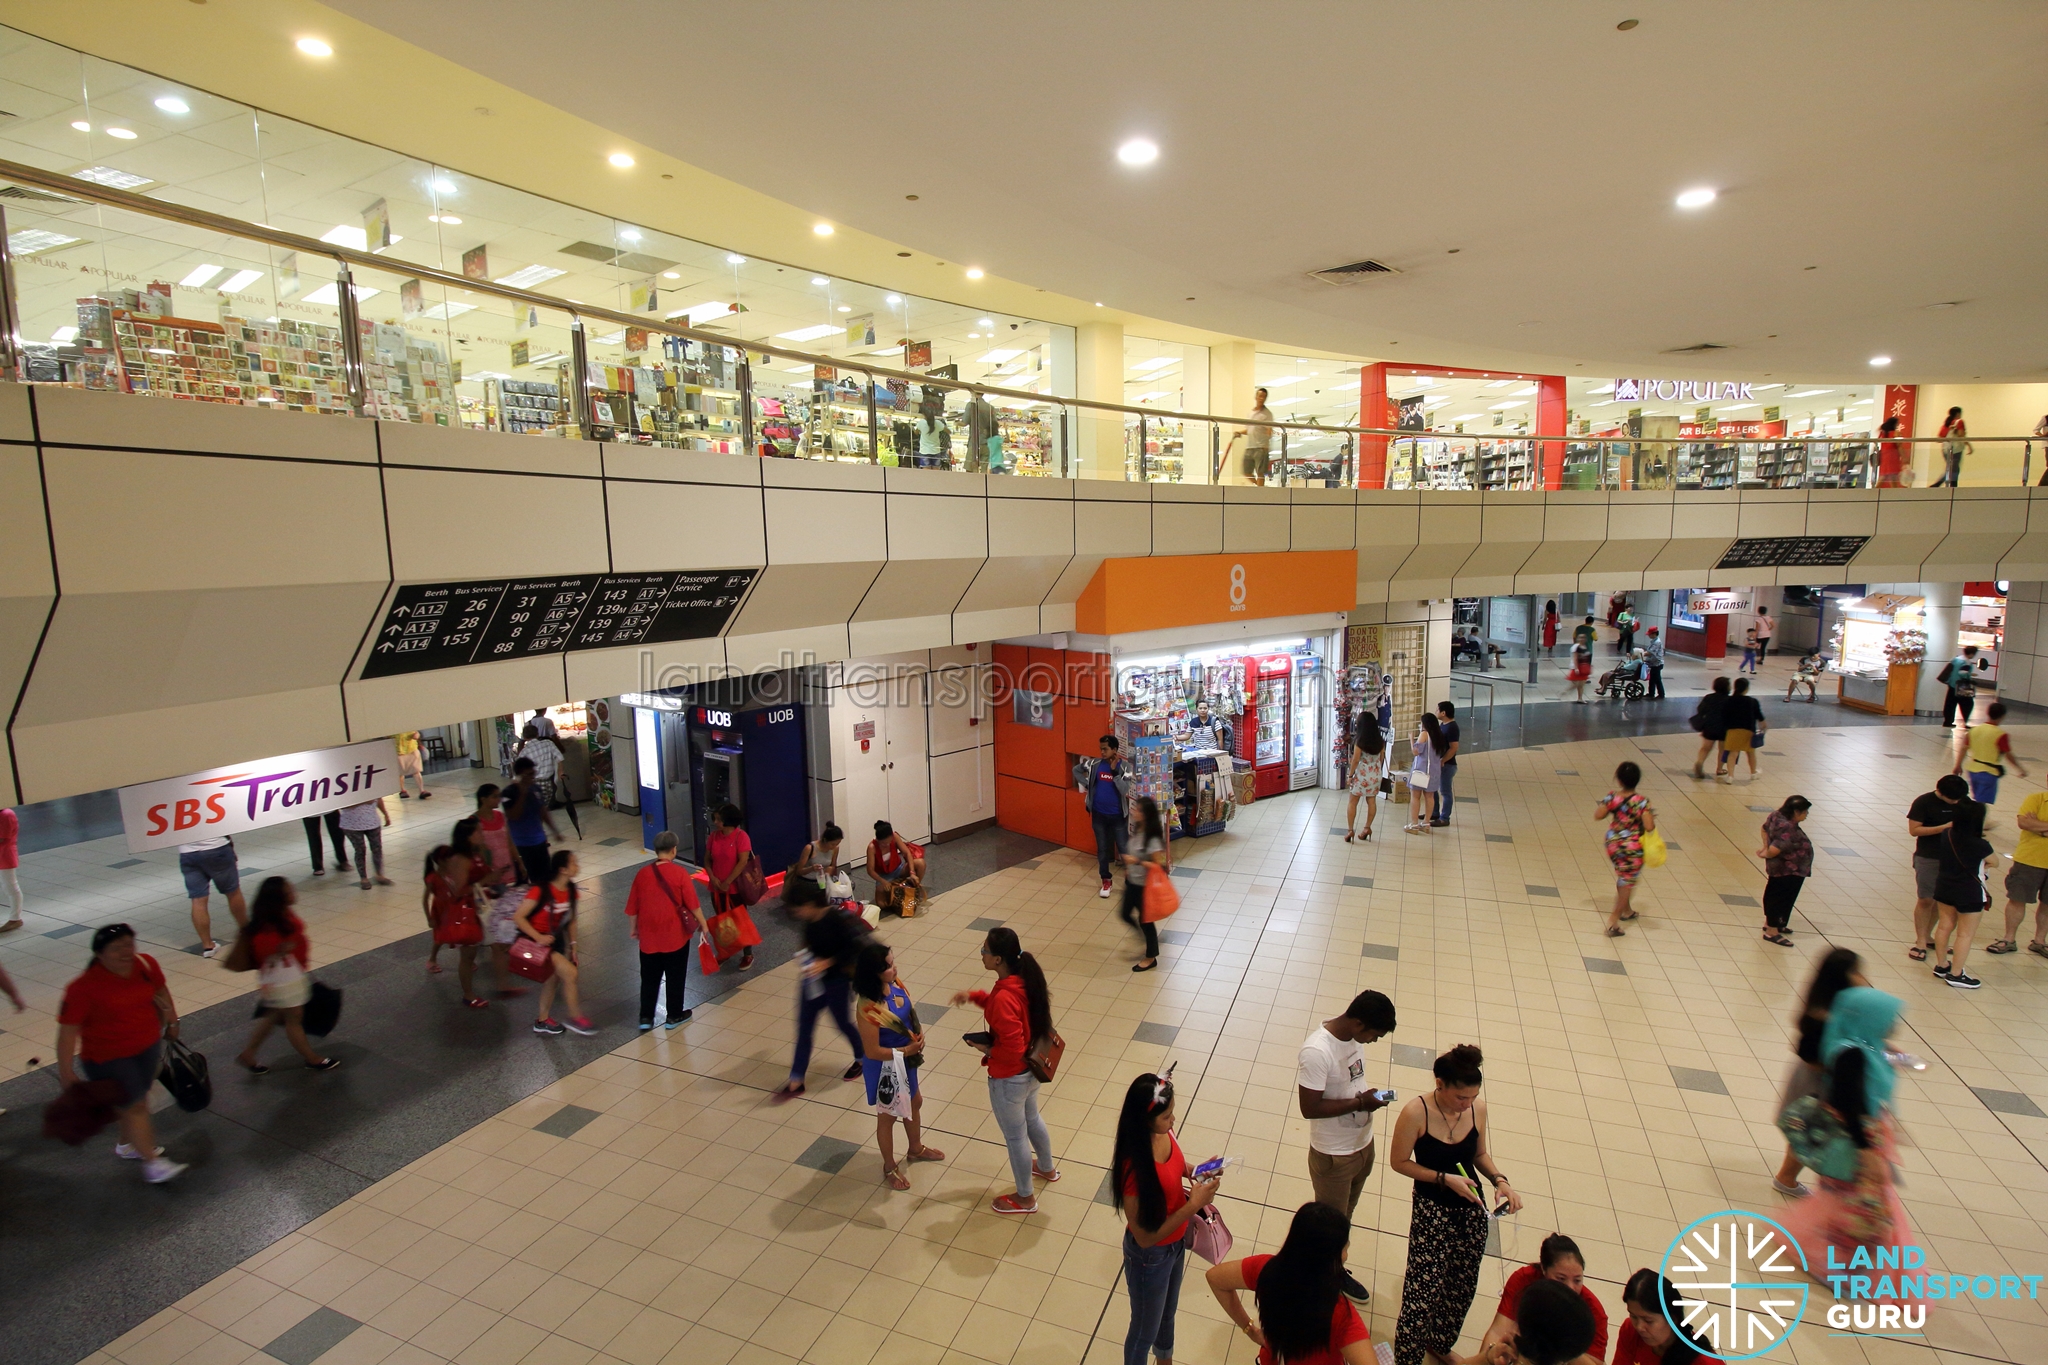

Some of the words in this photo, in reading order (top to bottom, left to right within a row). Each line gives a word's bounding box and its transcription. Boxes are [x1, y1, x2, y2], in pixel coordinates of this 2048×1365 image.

[89, 266, 139, 283] POPULAR
[161, 280, 206, 295] POPULAR
[225, 292, 267, 306] POPULAR
[284, 302, 322, 315] POPULAR
[1642, 379, 1754, 401] POPULAR
[532, 581, 557, 589] Services
[561, 580, 581, 588] Berth
[679, 574, 719, 585] Passenger
[1229, 563, 1247, 605] 8
[425, 589, 448, 597] Berth
[471, 585, 503, 594] Services
[604, 590, 628, 601] 143
[638, 589, 653, 599] A1
[674, 584, 703, 592] Service
[415, 603, 444, 616] A12
[465, 599, 488, 612] 26
[517, 596, 537, 608] 31
[555, 593, 573, 604] A5
[665, 600, 689, 609] Ticket
[690, 599, 713, 607] Office
[1692, 600, 1711, 611] SBS
[1712, 597, 1750, 611] Transit
[596, 604, 628, 615] 139M
[631, 603, 647, 613] A2
[1229, 604, 1246, 612] DAYS
[509, 611, 530, 624] 90
[547, 609, 564, 619] A6
[588, 618, 612, 630] 139
[623, 617, 639, 627] A3
[406, 621, 437, 634] A13
[457, 616, 480, 630] 28
[511, 627, 523, 638] 8
[538, 624, 557, 635] A7
[1357, 627, 1367, 635] ON
[1369, 626, 1378, 635] TO
[399, 638, 429, 651] A14
[442, 632, 472, 646] 155
[580, 632, 605, 644] 145
[615, 630, 631, 640] A4
[493, 642, 514, 654] 88
[530, 639, 548, 649] A9
[707, 709, 731, 727] UOB
[768, 708, 794, 724] UOB
[861, 714, 866, 722] 5
[146, 793, 226, 836] SBS
[219, 764, 387, 821] Transit
